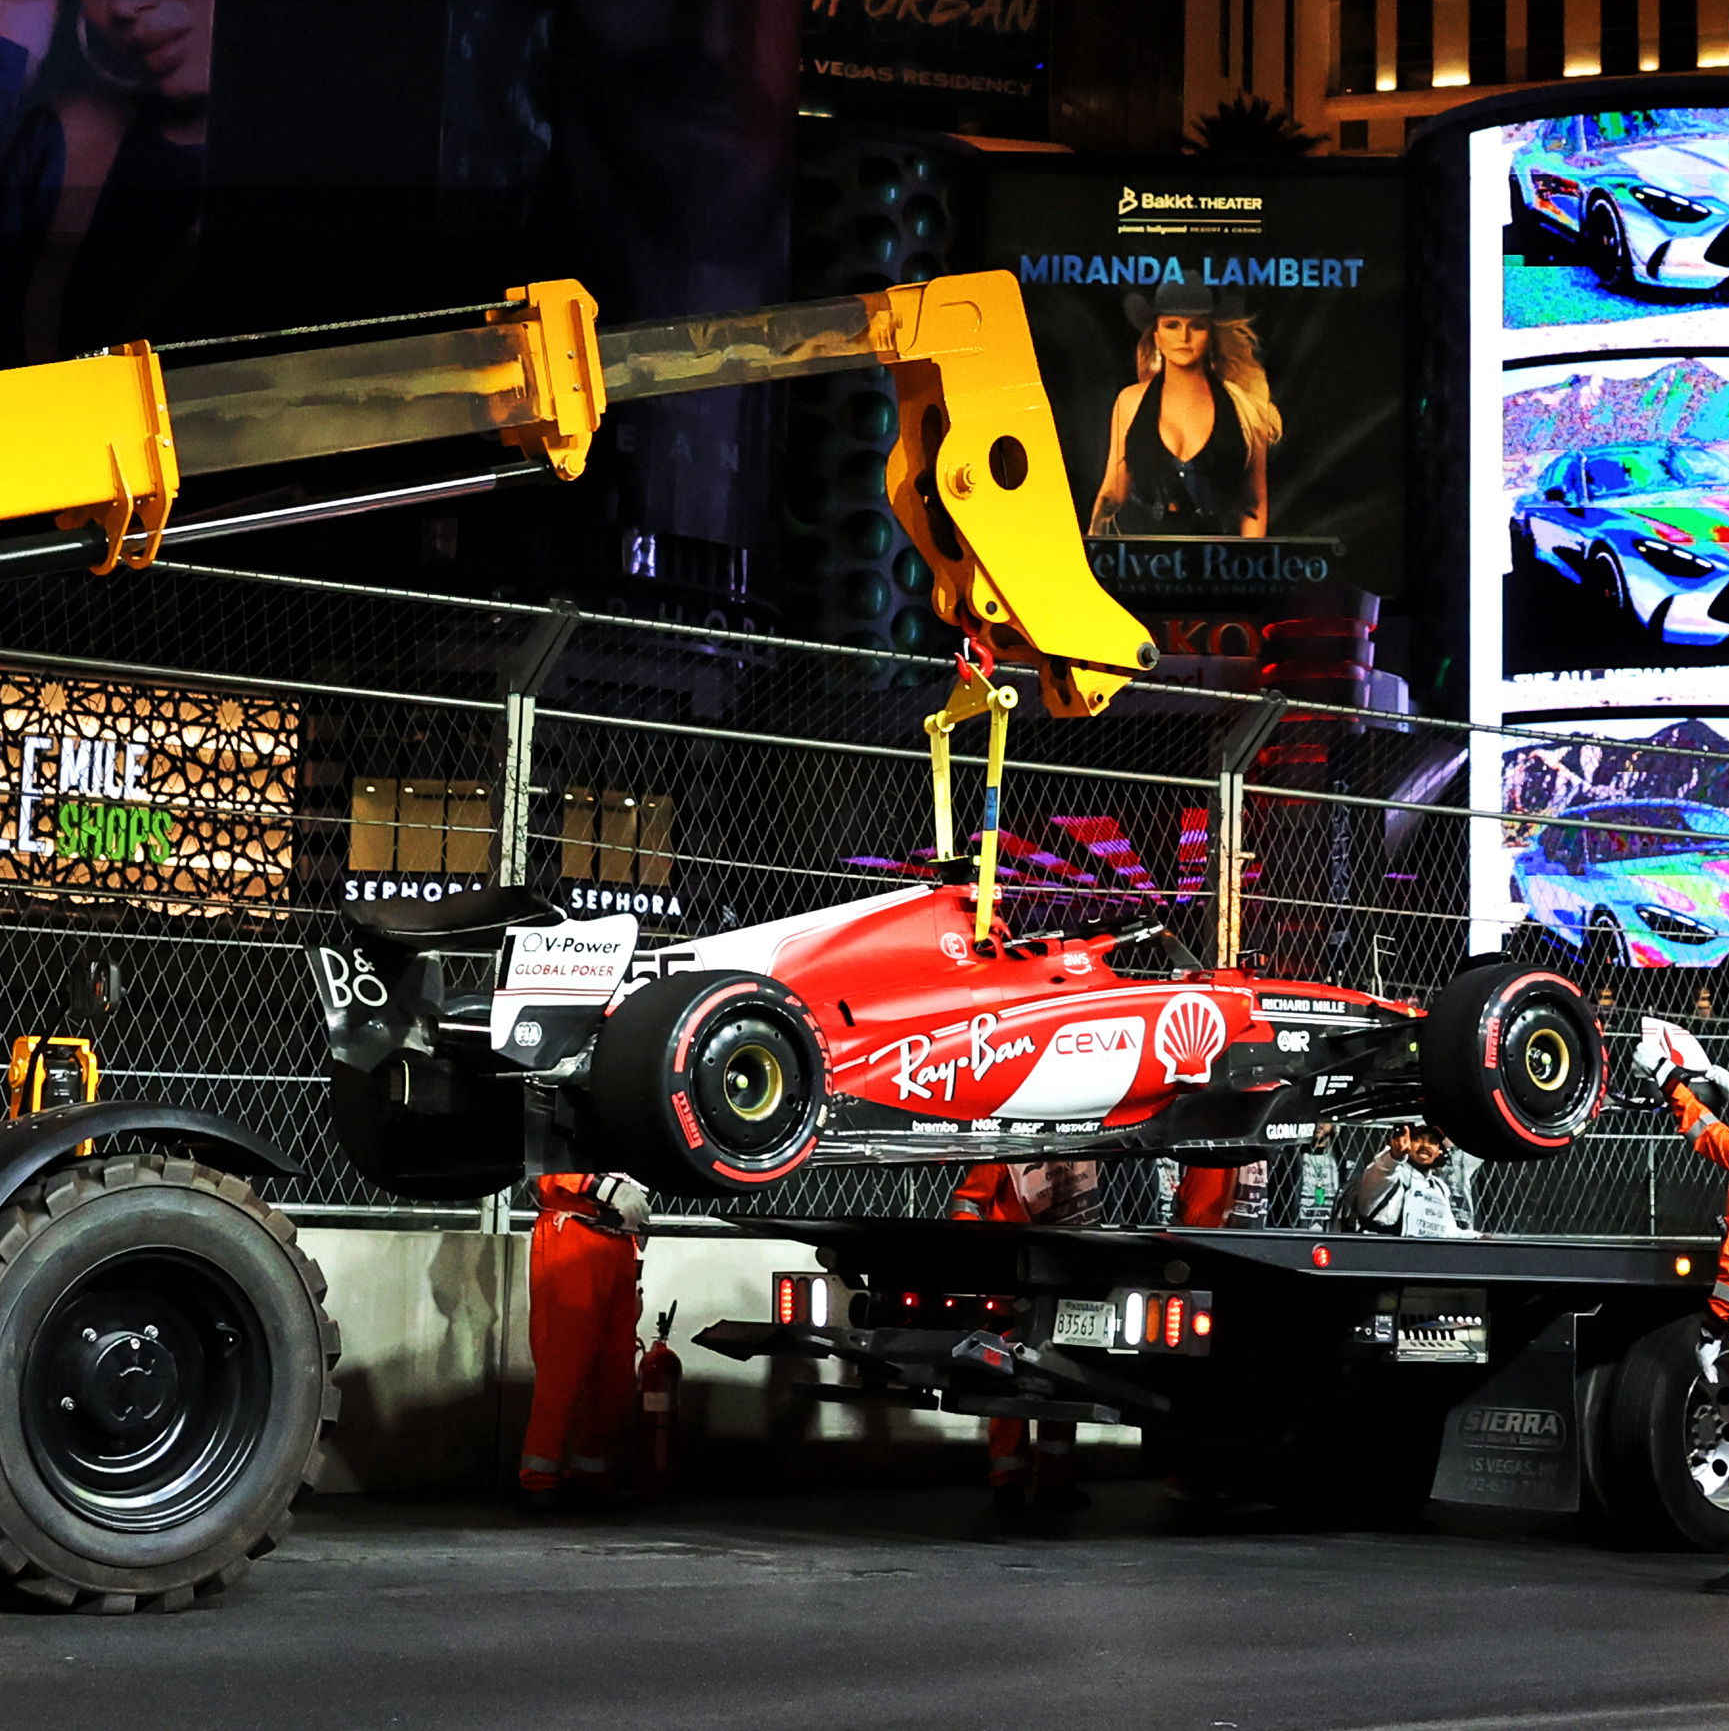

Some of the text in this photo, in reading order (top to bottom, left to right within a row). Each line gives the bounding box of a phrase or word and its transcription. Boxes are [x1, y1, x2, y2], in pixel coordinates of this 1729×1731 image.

[813, 58, 894, 83] VEGAS
[901, 67, 1033, 96] RESIDENCY
[1141, 193, 1262, 211] Bakkt THEATER
[1020, 255, 1364, 289] MIRANDA LAMBERT
[1086, 541, 1329, 582] elvet Rodeo
[60, 737, 148, 801] MILE
[57, 801, 172, 865] SHOPS
[571, 888, 682, 916] SEPHORA
[544, 937, 621, 954] V-Power
[515, 963, 566, 976] GLOBAL
[571, 965, 614, 977] POKER
[1063, 953, 1090, 966] aws
[1261, 998, 1345, 1013] RICHARD MILLE
[912, 1120, 959, 1133] brembo
[971, 1118, 1002, 1131] NGK
[1266, 1123, 1298, 1140] GLOBAL
[1057, 1313, 1095, 1336] 83563
[1464, 1410, 1560, 1436] SIERRA
